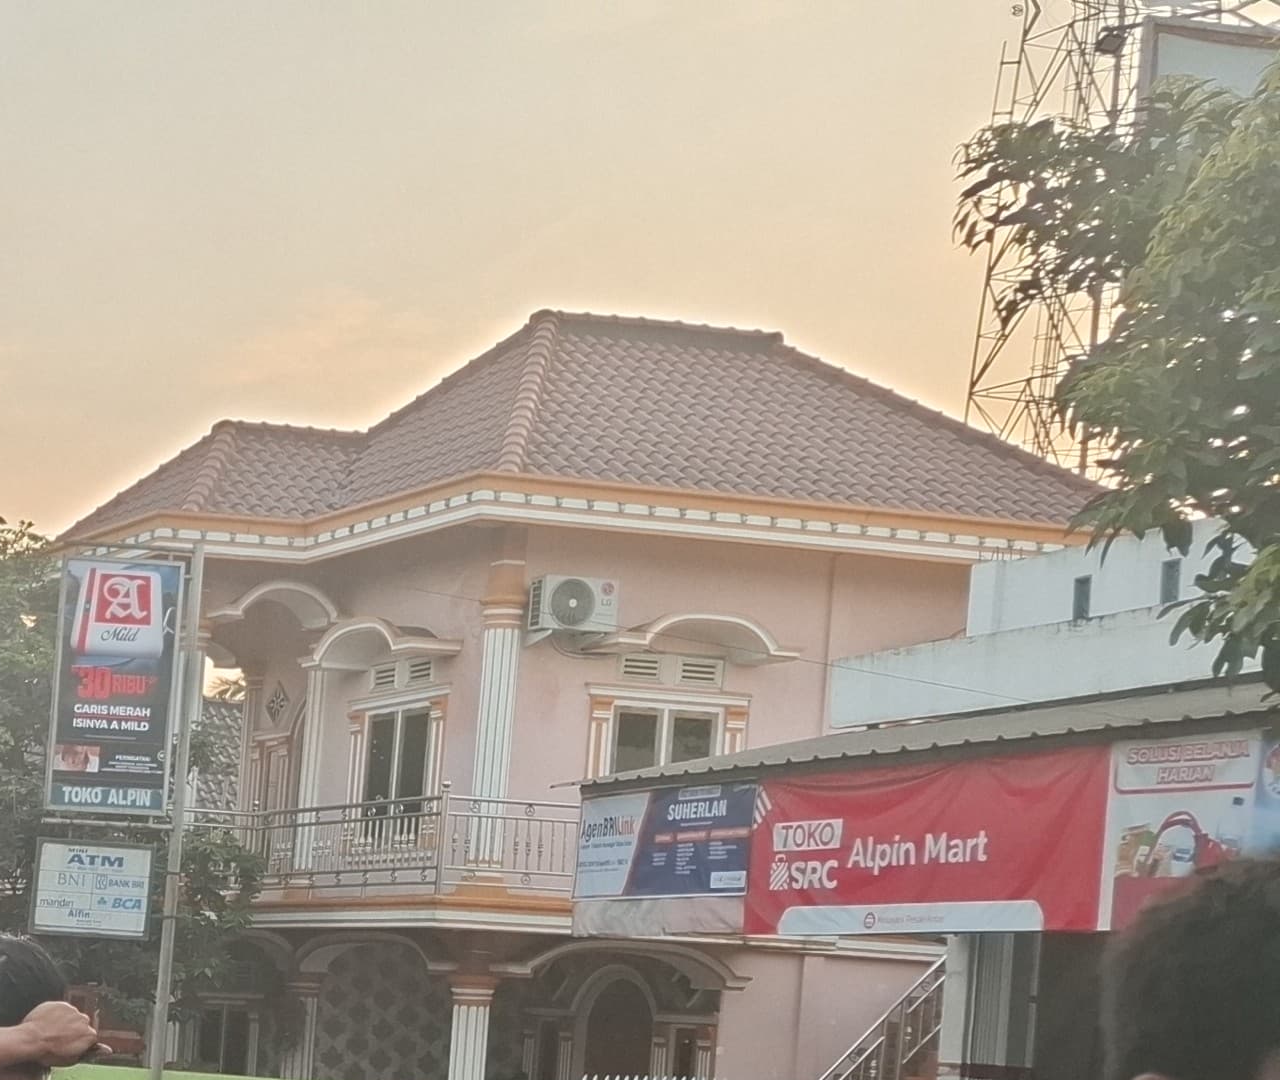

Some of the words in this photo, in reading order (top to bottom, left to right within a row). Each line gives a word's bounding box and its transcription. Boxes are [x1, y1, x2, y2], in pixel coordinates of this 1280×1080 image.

[100, 626, 141, 644] Mild
[73, 703, 108, 715] GARIS
[109, 705, 151, 717] MERAH
[72, 718, 109, 730] ISINYA
[109, 720, 120, 731] A
[121, 721, 149, 732] MILD
[1126, 744, 1182, 765] SOLUSI
[1156, 764, 1216, 784] HARIAN
[61, 786, 103, 804] TOKO
[107, 787, 152, 807] ALPIN
[666, 799, 728, 821] SUHERLAN
[781, 821, 835, 849] TOKO
[66, 853, 125, 868] ATM
[846, 833, 916, 876] Alpin
[923, 829, 989, 865] Mart
[56, 872, 87, 888] BNI
[790, 859, 839, 891] SRC
[111, 897, 143, 911] BCA
